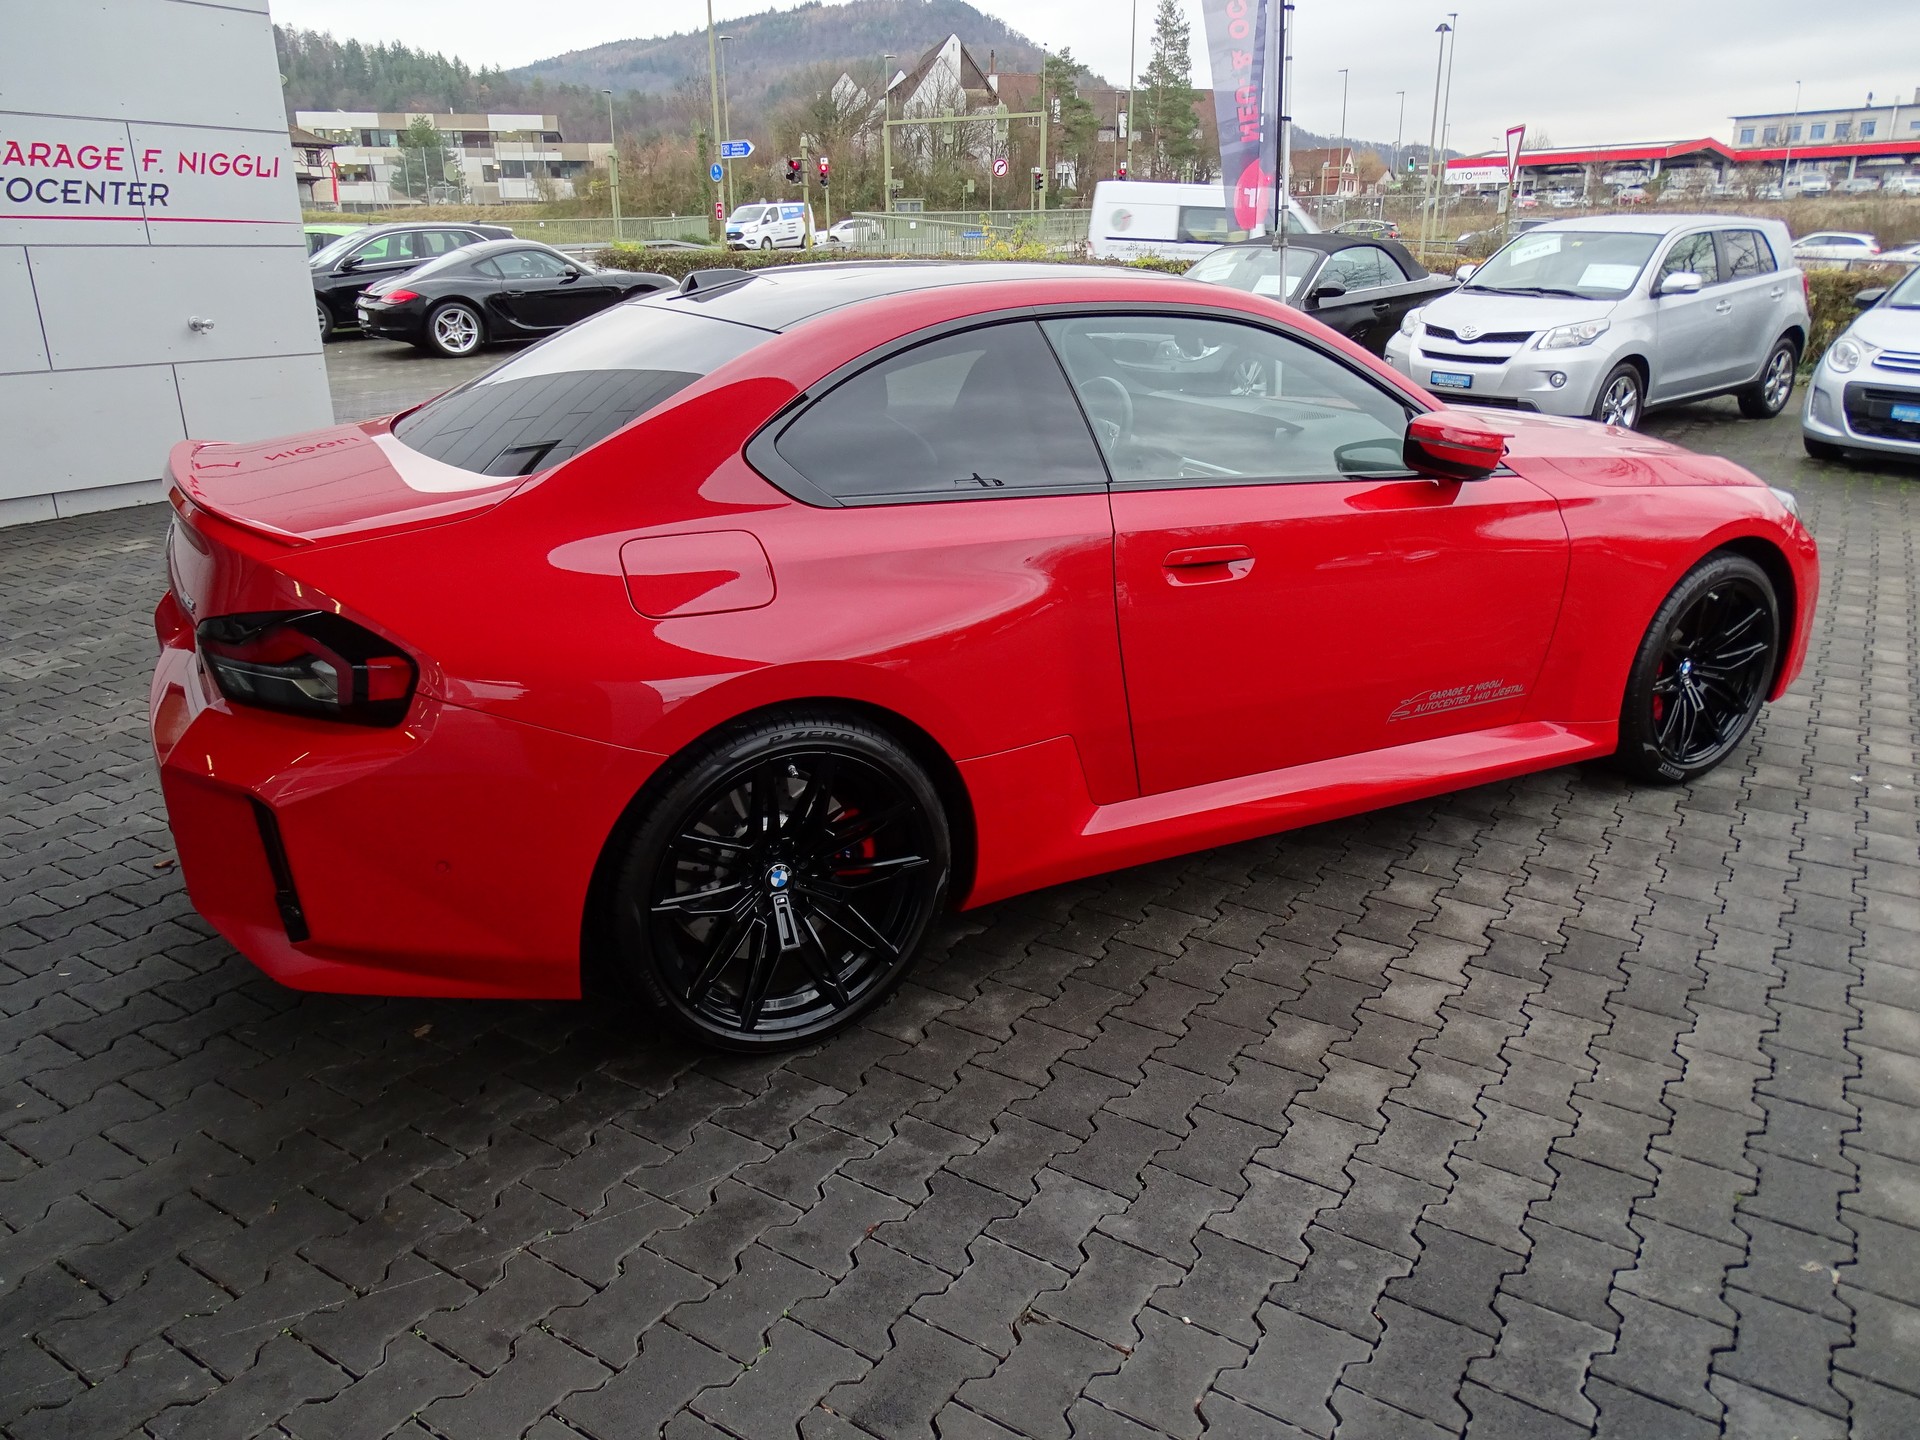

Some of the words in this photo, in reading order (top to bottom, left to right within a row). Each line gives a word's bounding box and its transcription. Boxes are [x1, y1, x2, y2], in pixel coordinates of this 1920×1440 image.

[0, 140, 125, 172] ARAGE
[142, 149, 164, 174] F.
[178, 151, 280, 178] NIGGLI
[1429, 686, 1465, 700] GARAGE
[1413, 695, 1471, 713] AUTOCENTER
